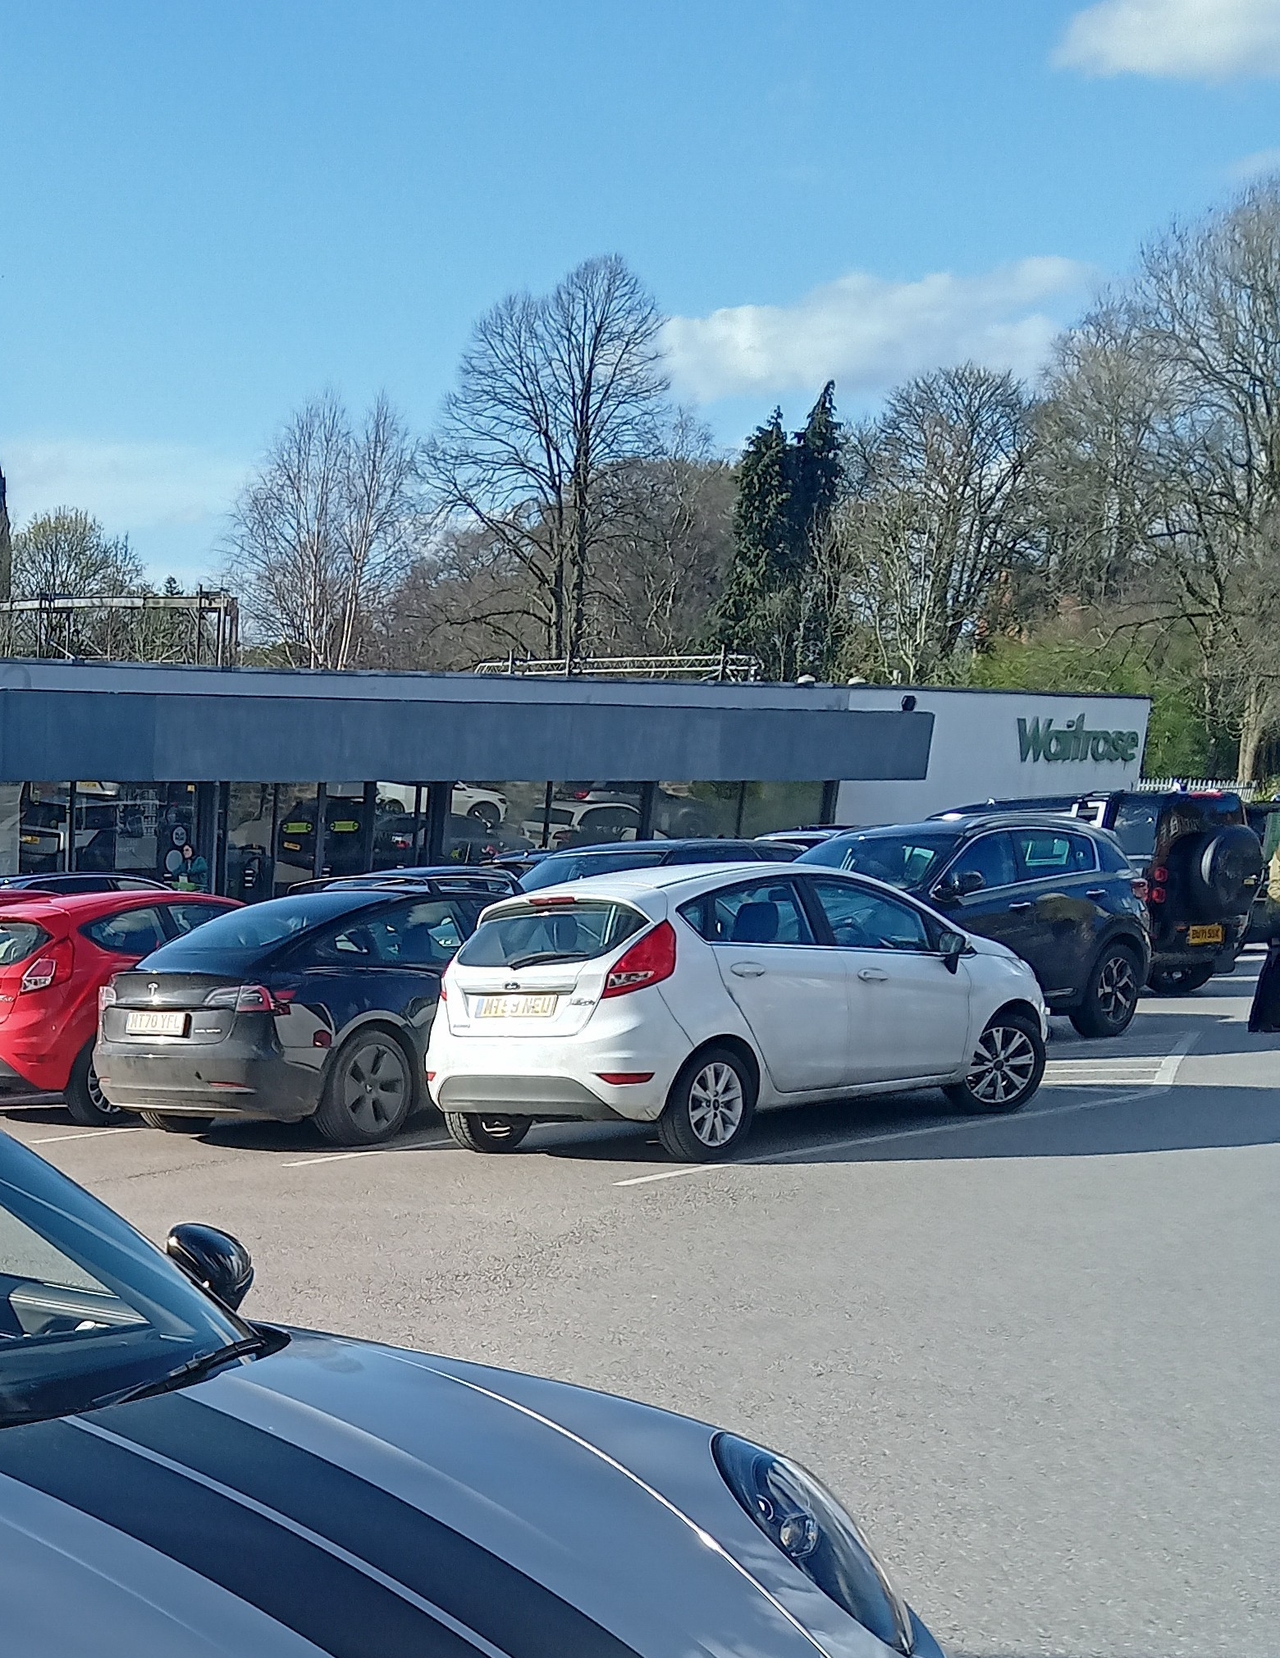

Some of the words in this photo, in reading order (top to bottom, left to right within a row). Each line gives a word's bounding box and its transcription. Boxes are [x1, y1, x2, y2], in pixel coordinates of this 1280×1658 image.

[1017, 713, 1139, 762] Waitrose
[130, 1014, 158, 1028] MT70
[161, 1014, 180, 1029] YFL
